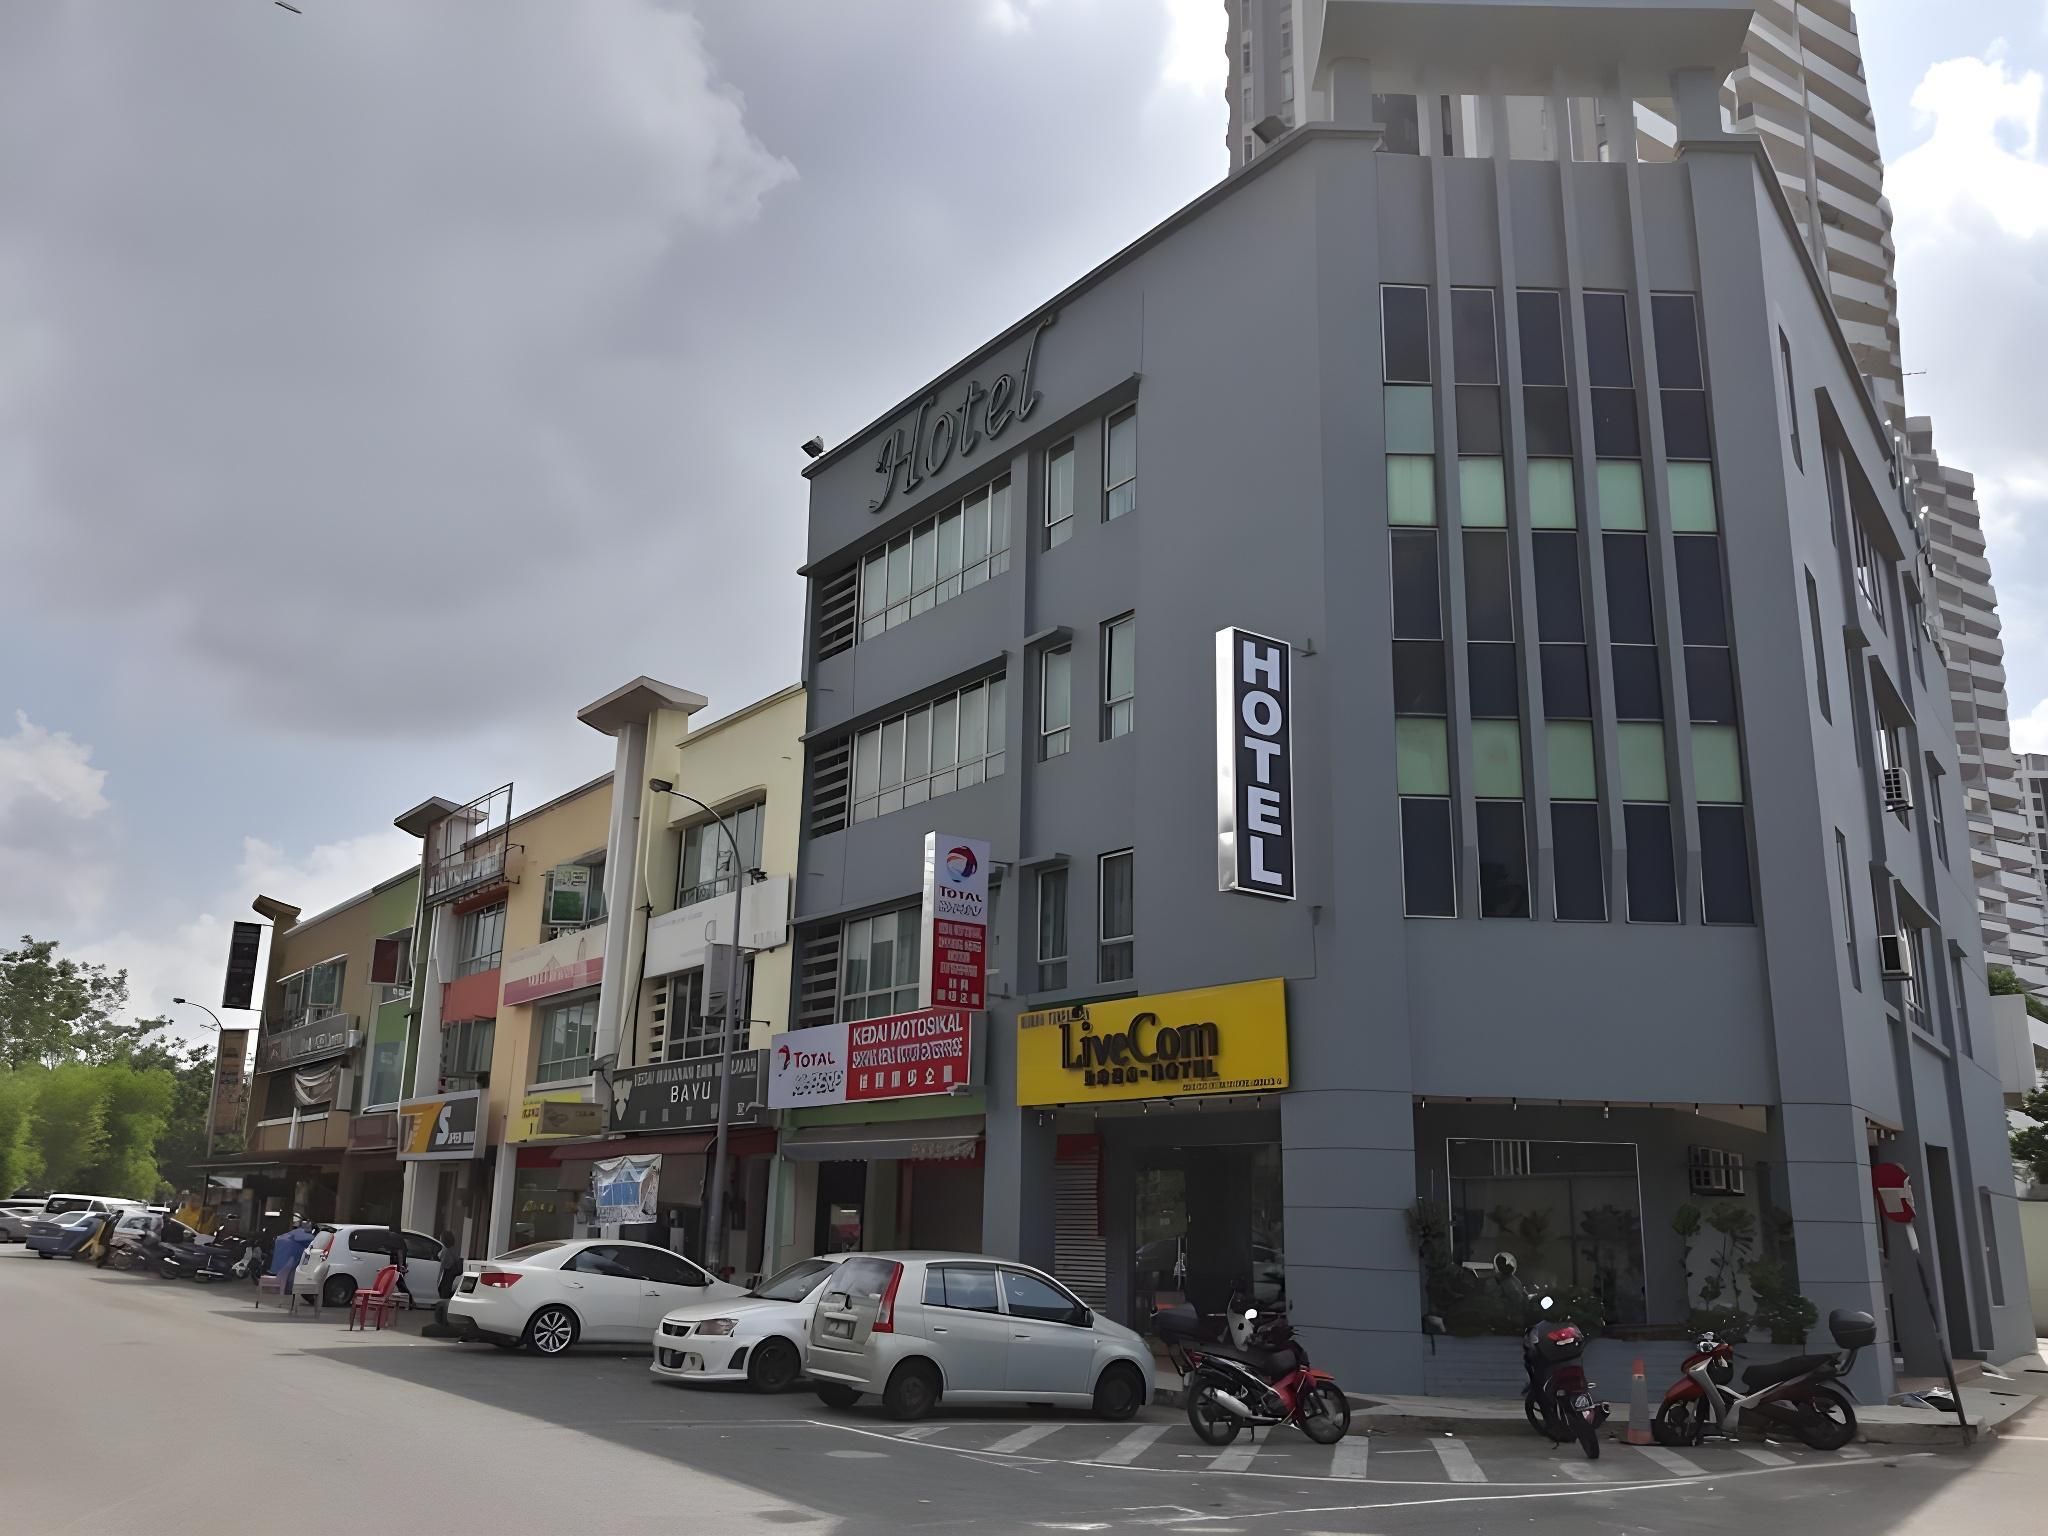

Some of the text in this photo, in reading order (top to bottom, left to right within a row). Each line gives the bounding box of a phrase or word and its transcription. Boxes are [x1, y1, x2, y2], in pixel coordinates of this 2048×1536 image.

[866, 316, 1053, 514] Hotel
[1241, 640, 1283, 886] HOTEL
[939, 885, 983, 903] TOTAL
[890, 1013, 963, 1041] MOTOSIKAL
[793, 1051, 836, 1068] TOTAL
[670, 1081, 712, 1103] BAYU
